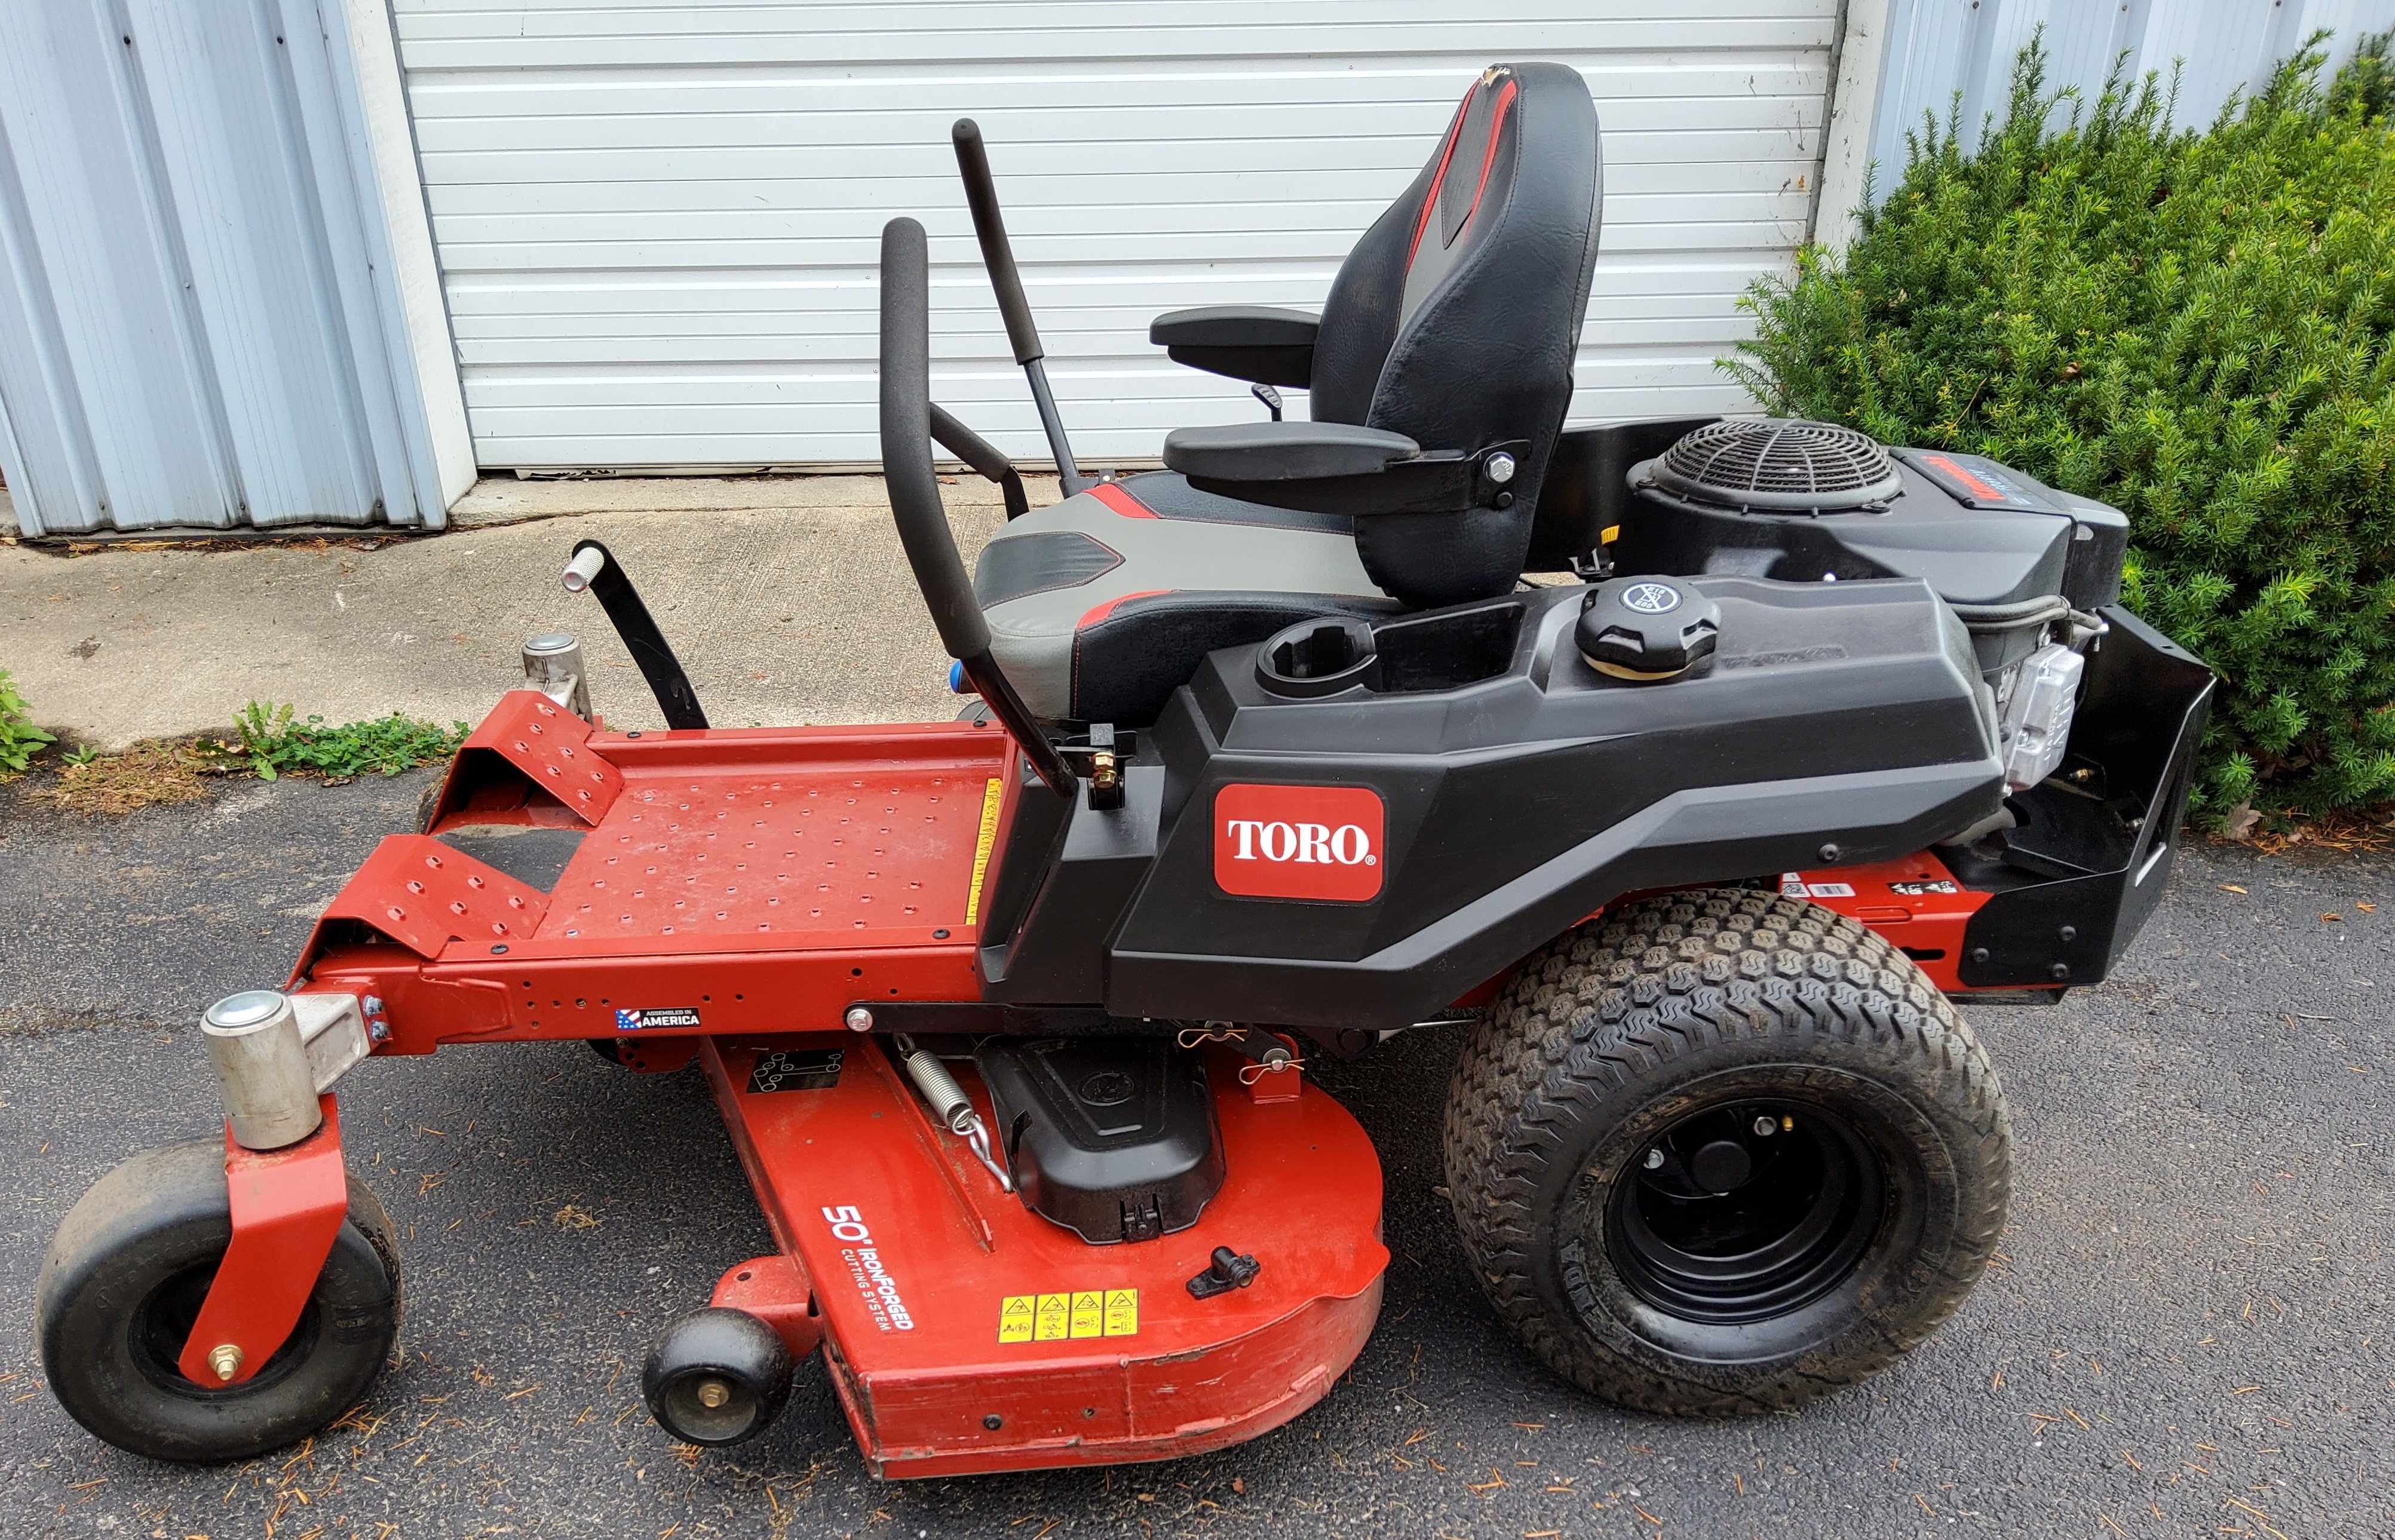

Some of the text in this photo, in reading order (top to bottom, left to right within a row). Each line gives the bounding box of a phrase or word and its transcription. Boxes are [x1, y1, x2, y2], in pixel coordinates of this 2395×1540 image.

[642, 1016, 700, 1026] AMERICA
[841, 1248, 892, 1332] CUTTING SYSTEM
[857, 1248, 915, 1331] IRONFORGED
[1560, 1240, 1633, 1354] KENDA
